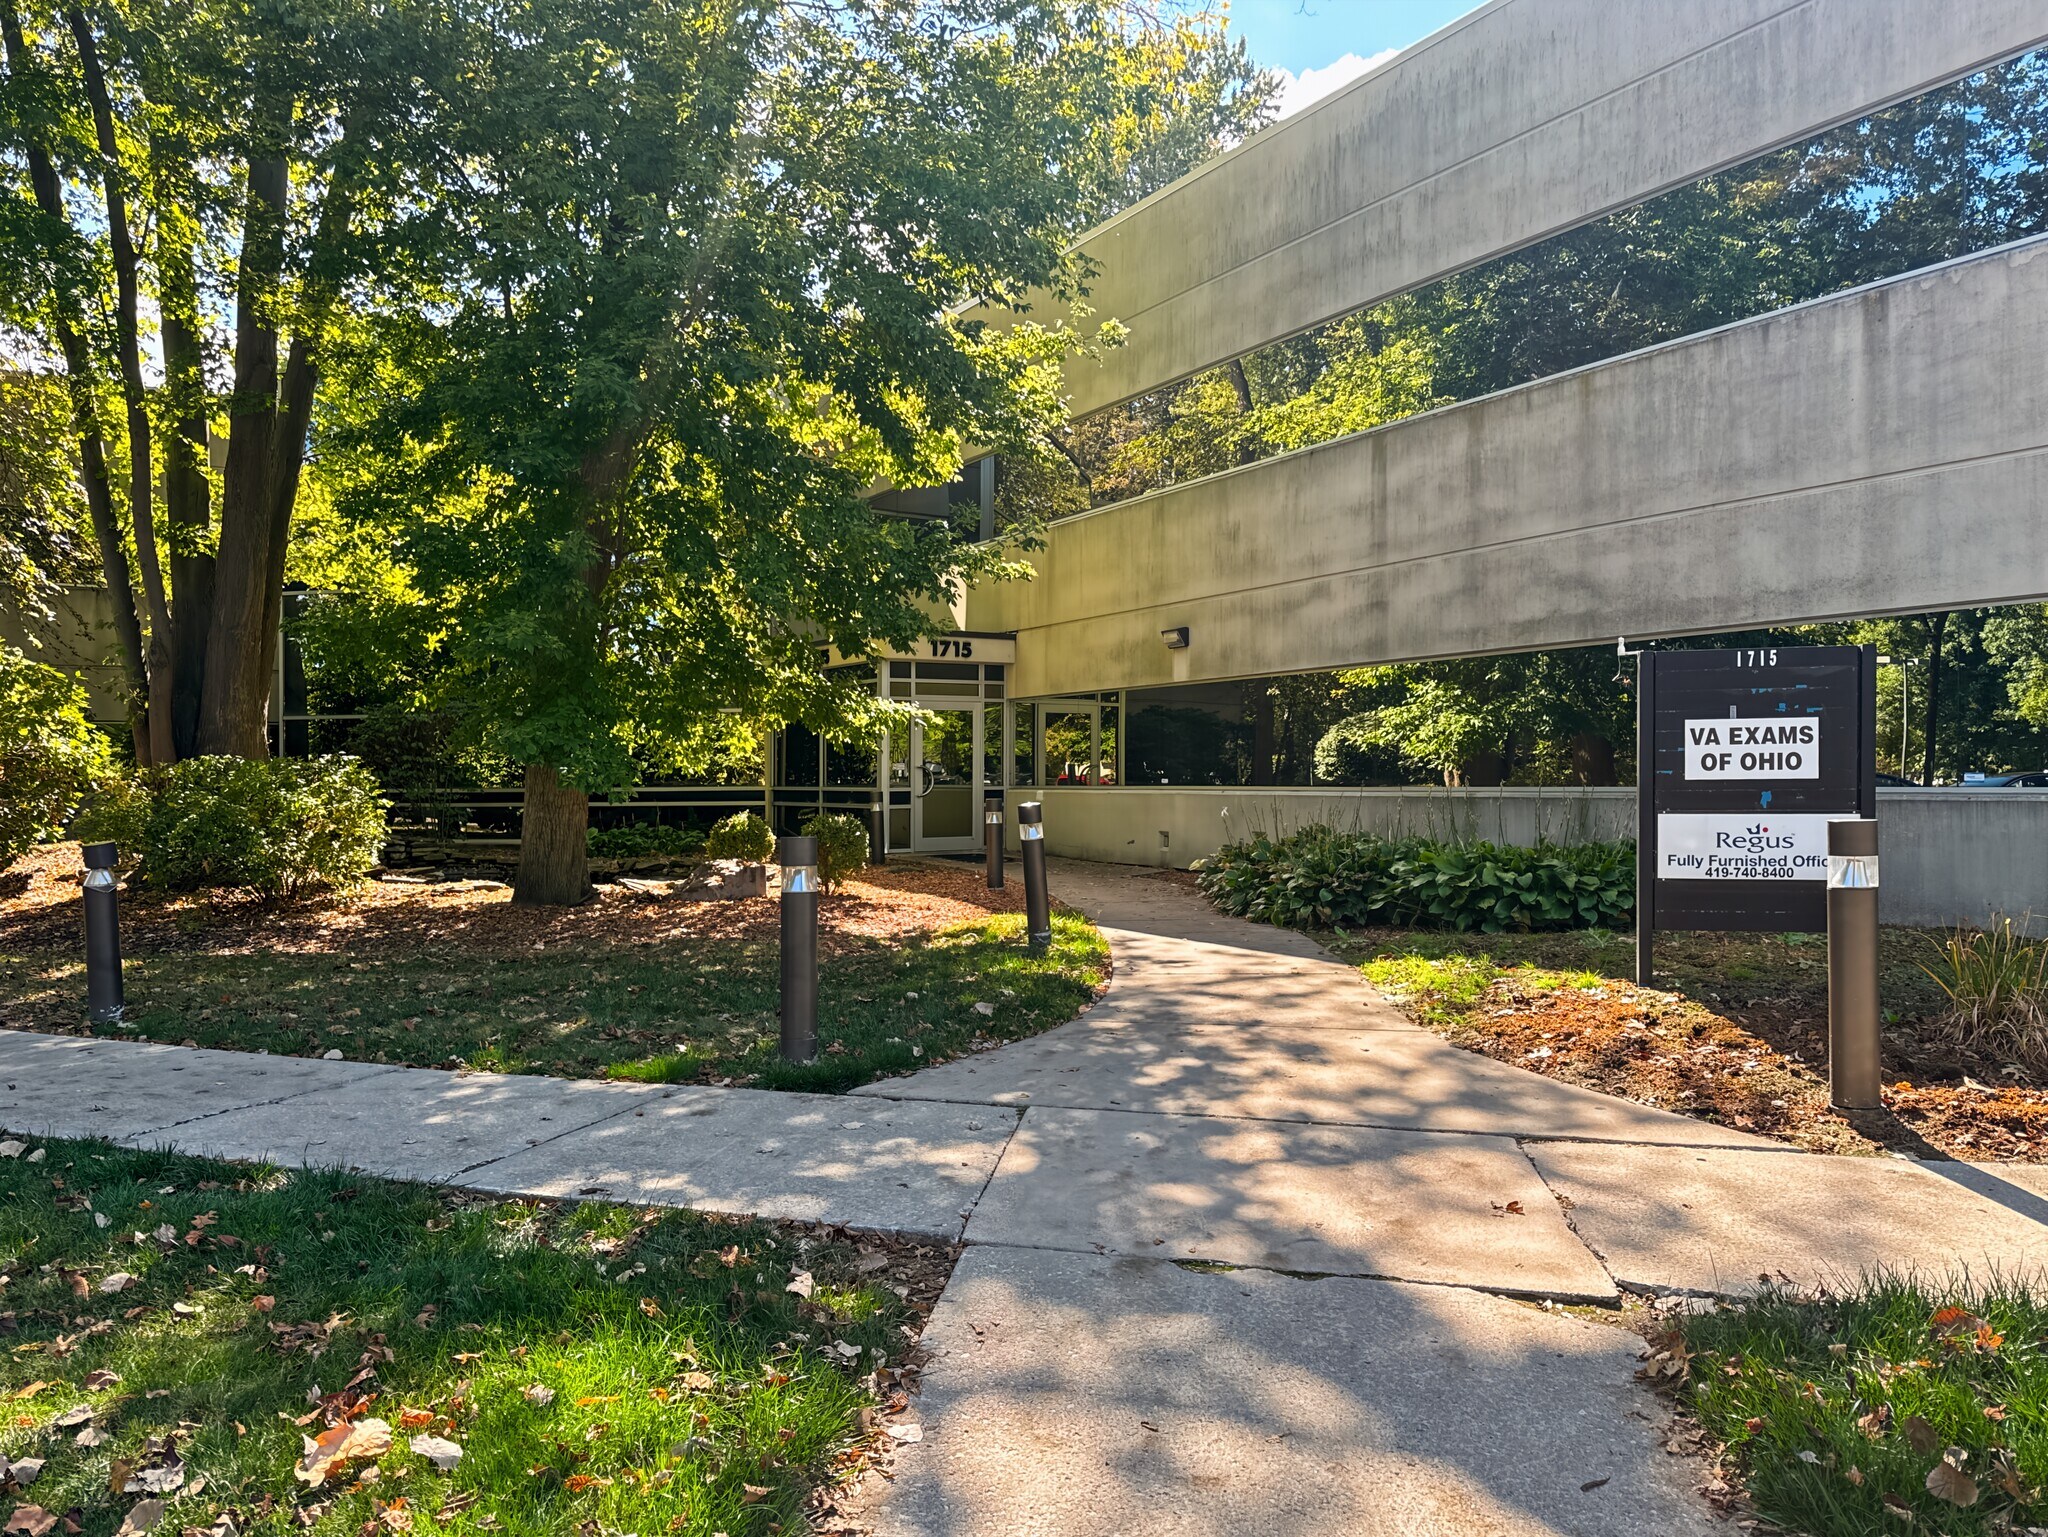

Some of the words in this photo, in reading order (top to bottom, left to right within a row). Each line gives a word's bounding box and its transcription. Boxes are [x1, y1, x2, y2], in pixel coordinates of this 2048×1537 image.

[930, 640, 972, 658] 1715
[1736, 650, 1777, 668] 1715
[1690, 727, 1720, 746] VA
[1729, 725, 1814, 745] EXAMS
[1701, 753, 1732, 772] OF
[1740, 752, 1802, 771] OHIO
[1716, 832, 1794, 853] Regus
[1668, 855, 1704, 868] Fully
[1709, 855, 1788, 867] Furnished
[1793, 855, 1828, 867] Offic
[1705, 867, 1794, 878] 419-740-8400
